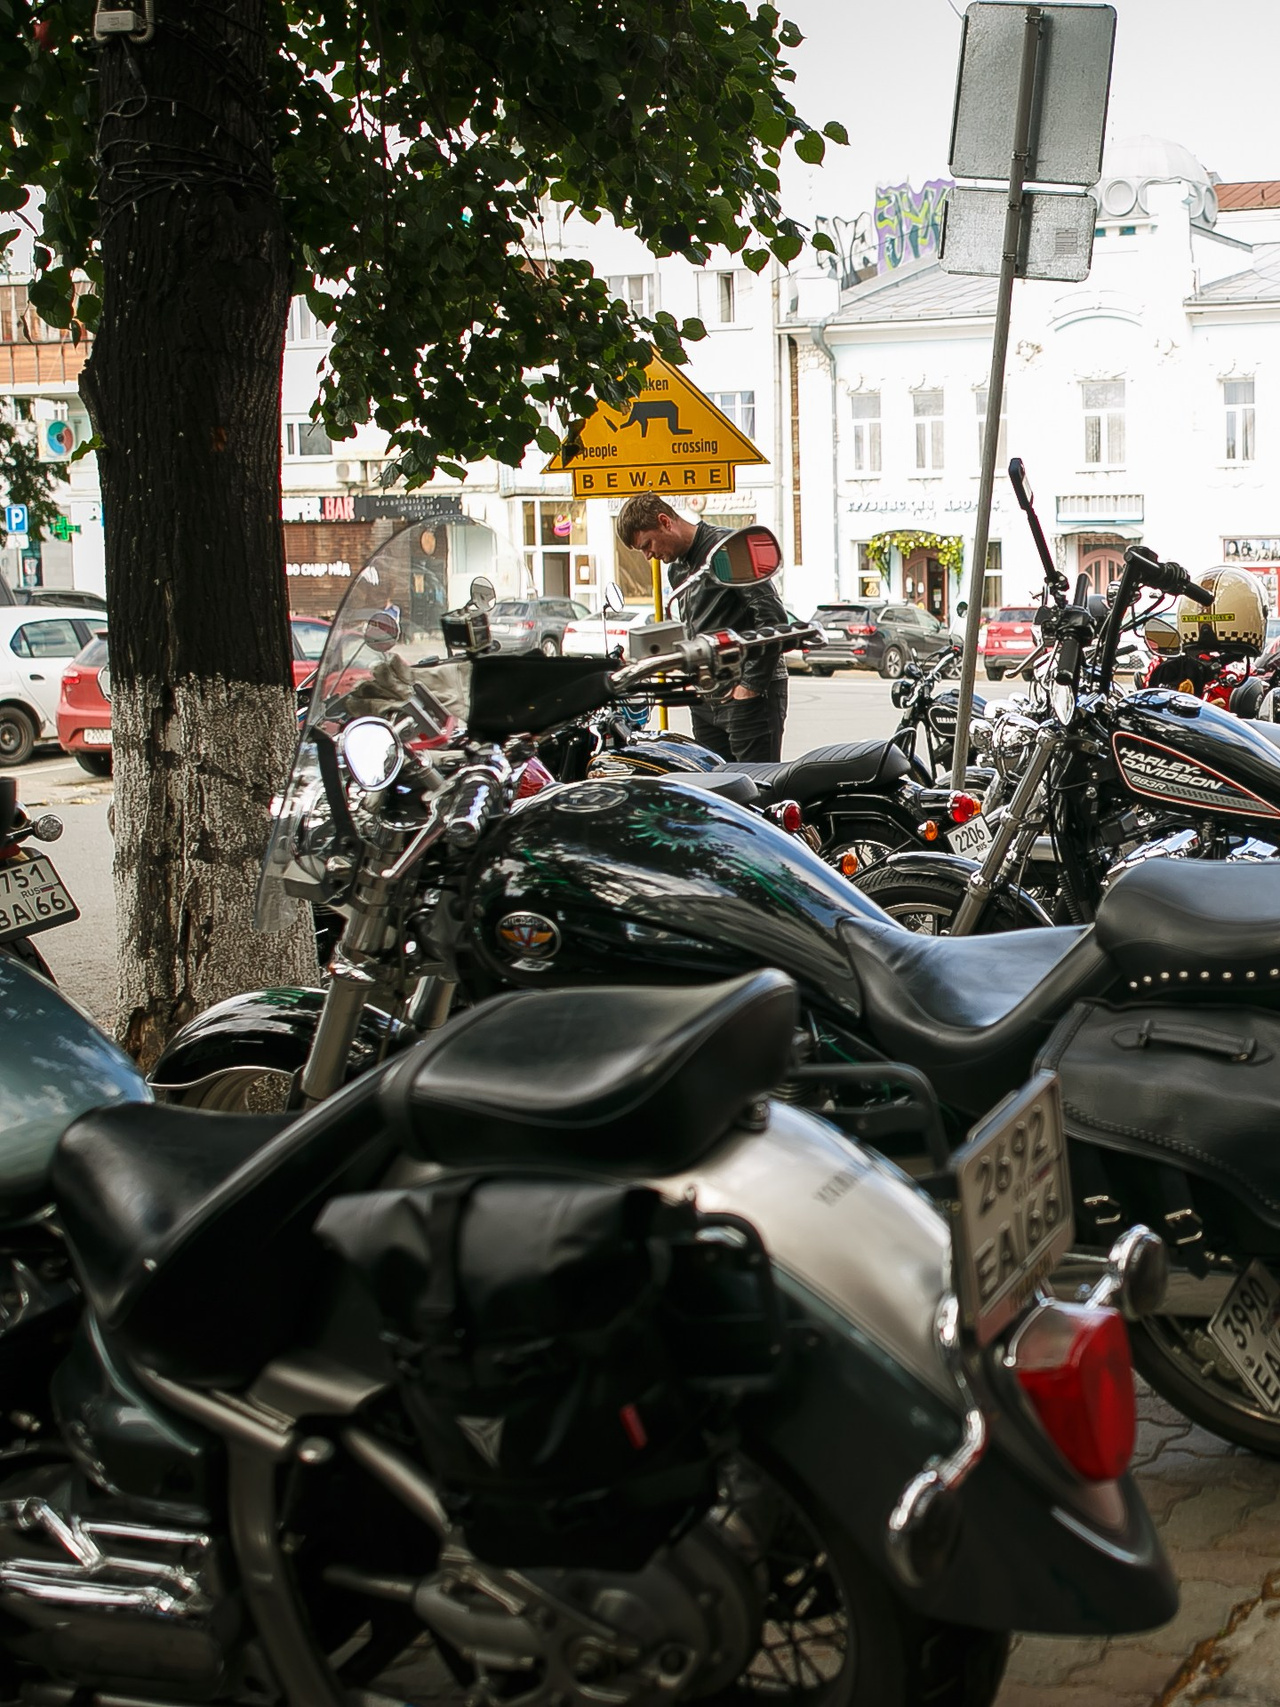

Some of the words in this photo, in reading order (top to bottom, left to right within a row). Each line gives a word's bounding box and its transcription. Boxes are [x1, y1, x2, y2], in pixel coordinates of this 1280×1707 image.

[583, 443, 618, 461] people
[671, 438, 718, 455] crossing
[583, 469, 722, 489] BEWARE
[1119, 747, 1202, 775] HARLEY-
[1121, 758, 1224, 790] DAVIDSON
[1131, 775, 1167, 790] 883R
[955, 823, 985, 853] 2206
[0, 863, 46, 895] 751
[21, 886, 41, 899] RUS
[36, 891, 67, 916] 66
[974, 1103, 1048, 1216] 2692
[1027, 1172, 1061, 1243] 66
[1222, 1277, 1271, 1350] 3990
